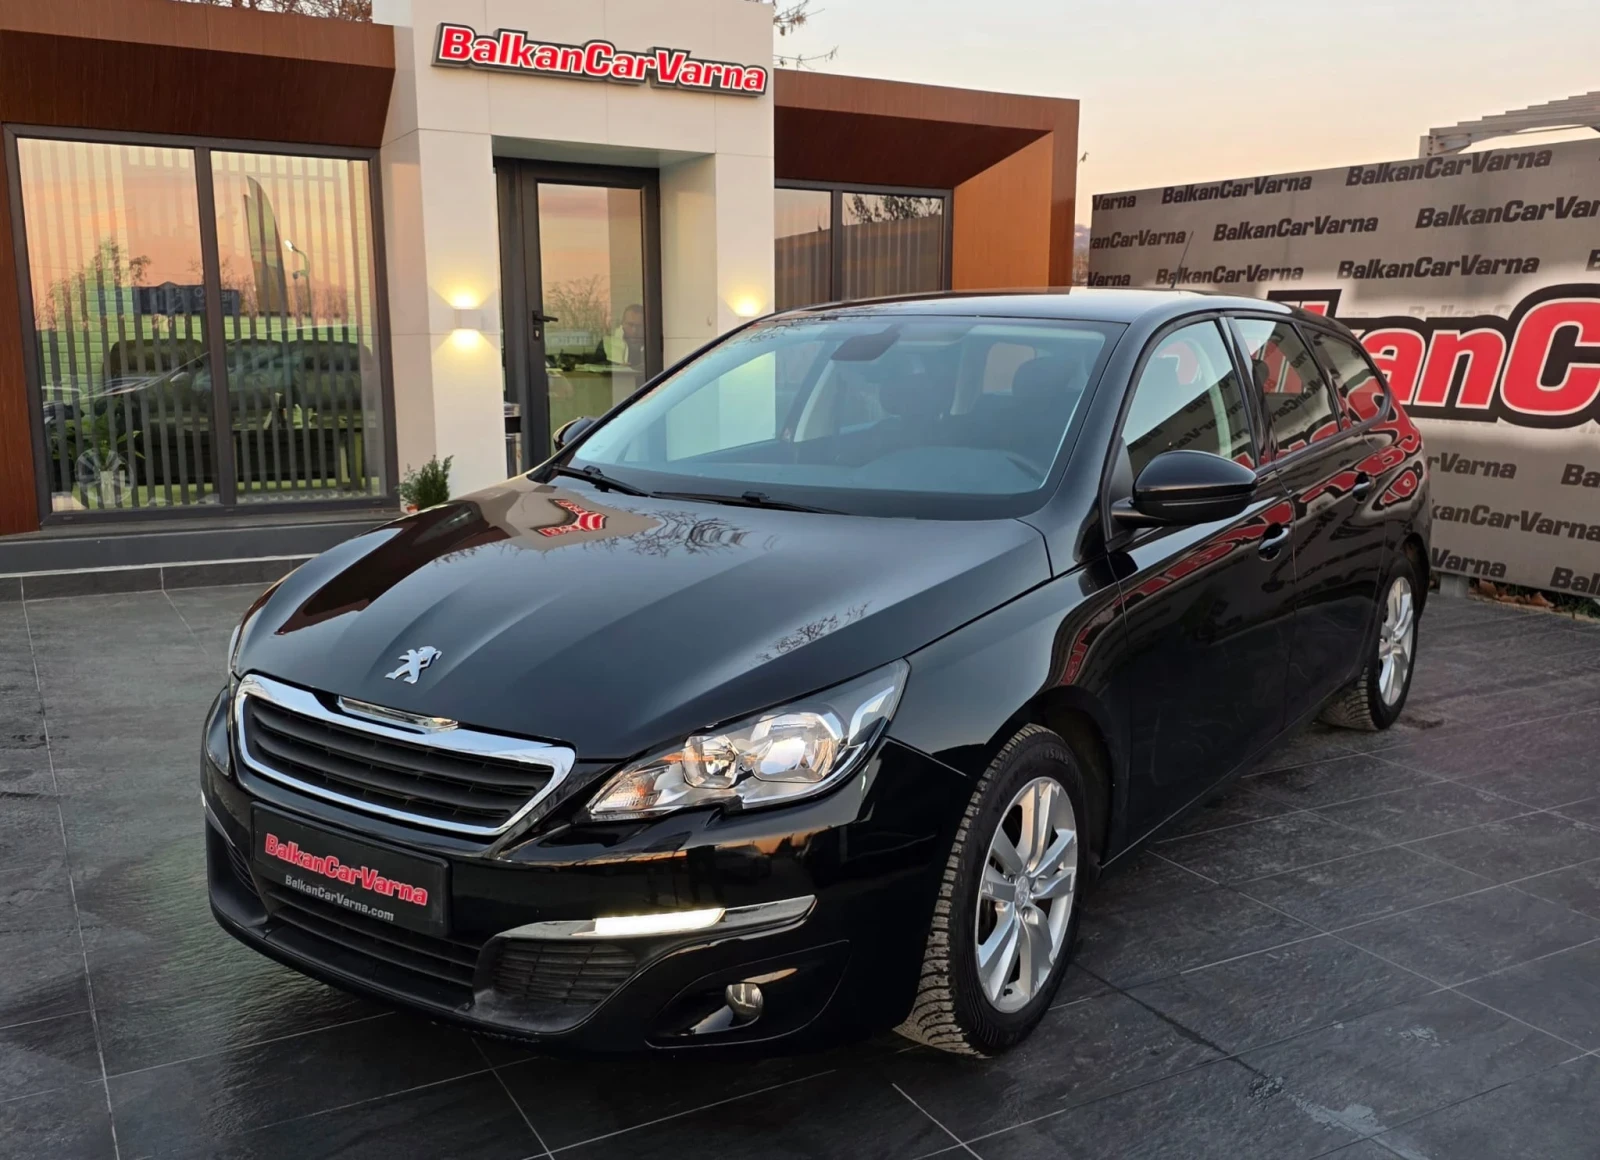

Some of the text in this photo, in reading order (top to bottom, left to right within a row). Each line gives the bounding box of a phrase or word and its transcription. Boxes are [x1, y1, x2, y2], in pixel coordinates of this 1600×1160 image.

[440, 26, 766, 92] BalkanCarVarna
[1345, 150, 1552, 187] BalkanCarVarna
[1161, 176, 1312, 204] BalkanCarVarna
[1213, 215, 1379, 242] BalkanCarVarna
[1155, 265, 1304, 285] BalkanCarVarna
[1337, 254, 1540, 280] BalkanCarVarna
[1300, 298, 1600, 416] anC
[264, 833, 428, 907] BalkanCarVarna
[285, 874, 394, 922] BalkanCarVarna.com
